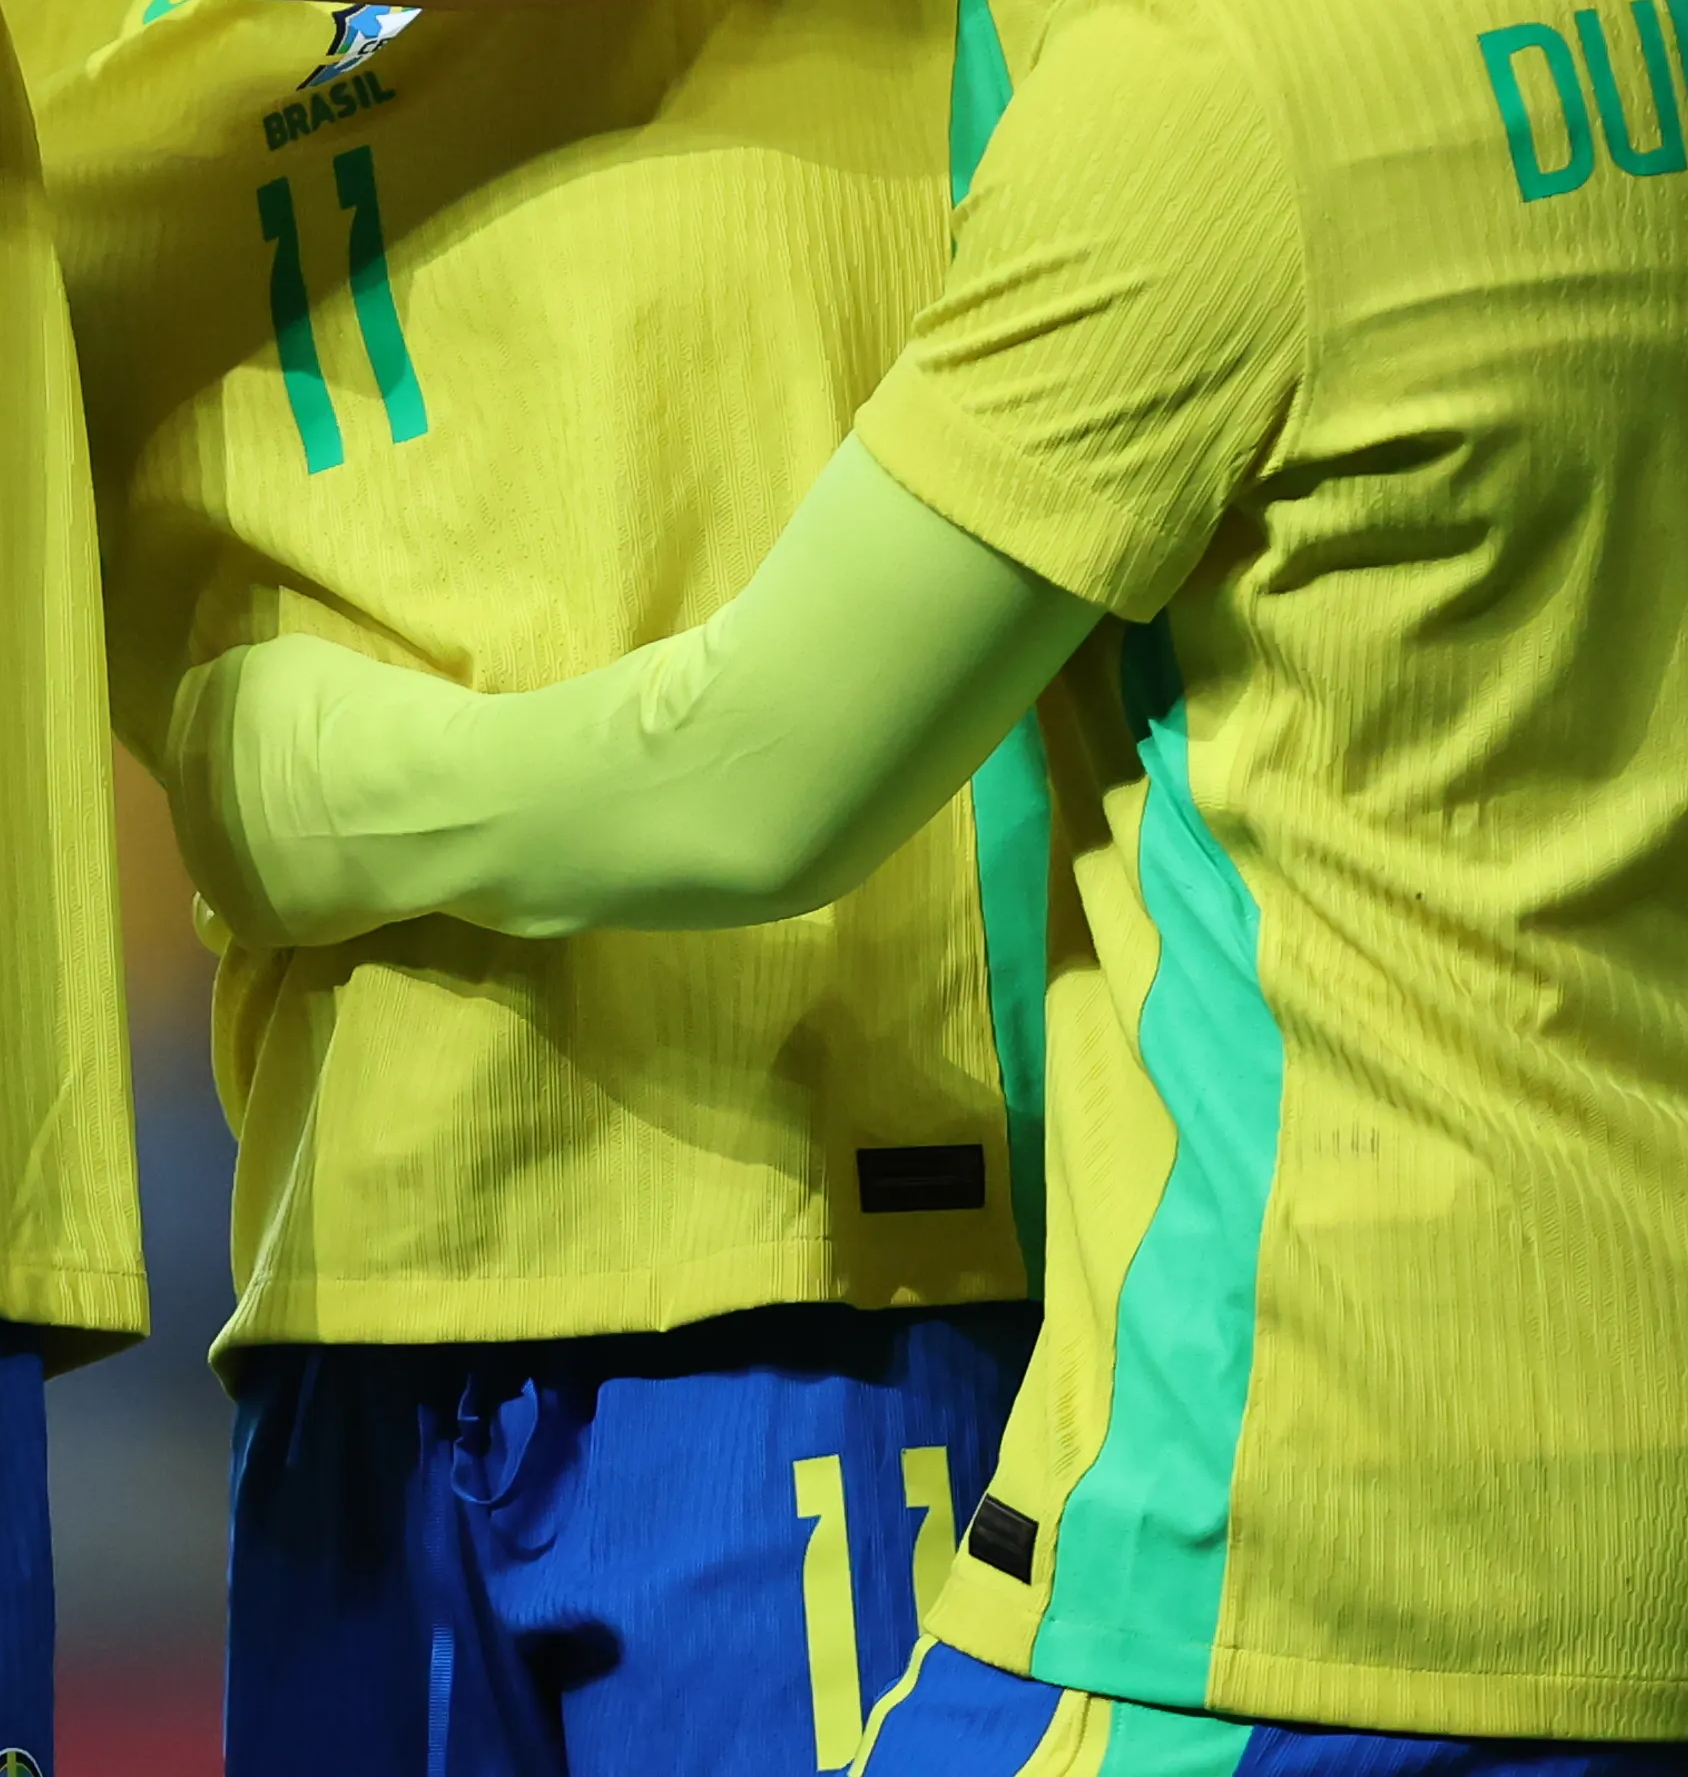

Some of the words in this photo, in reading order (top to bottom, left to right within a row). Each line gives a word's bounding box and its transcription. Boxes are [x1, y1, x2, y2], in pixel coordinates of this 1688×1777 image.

[263, 71, 396, 151] BRASIL
[257, 145, 429, 474] 11
[793, 1446, 957, 1771] 11
